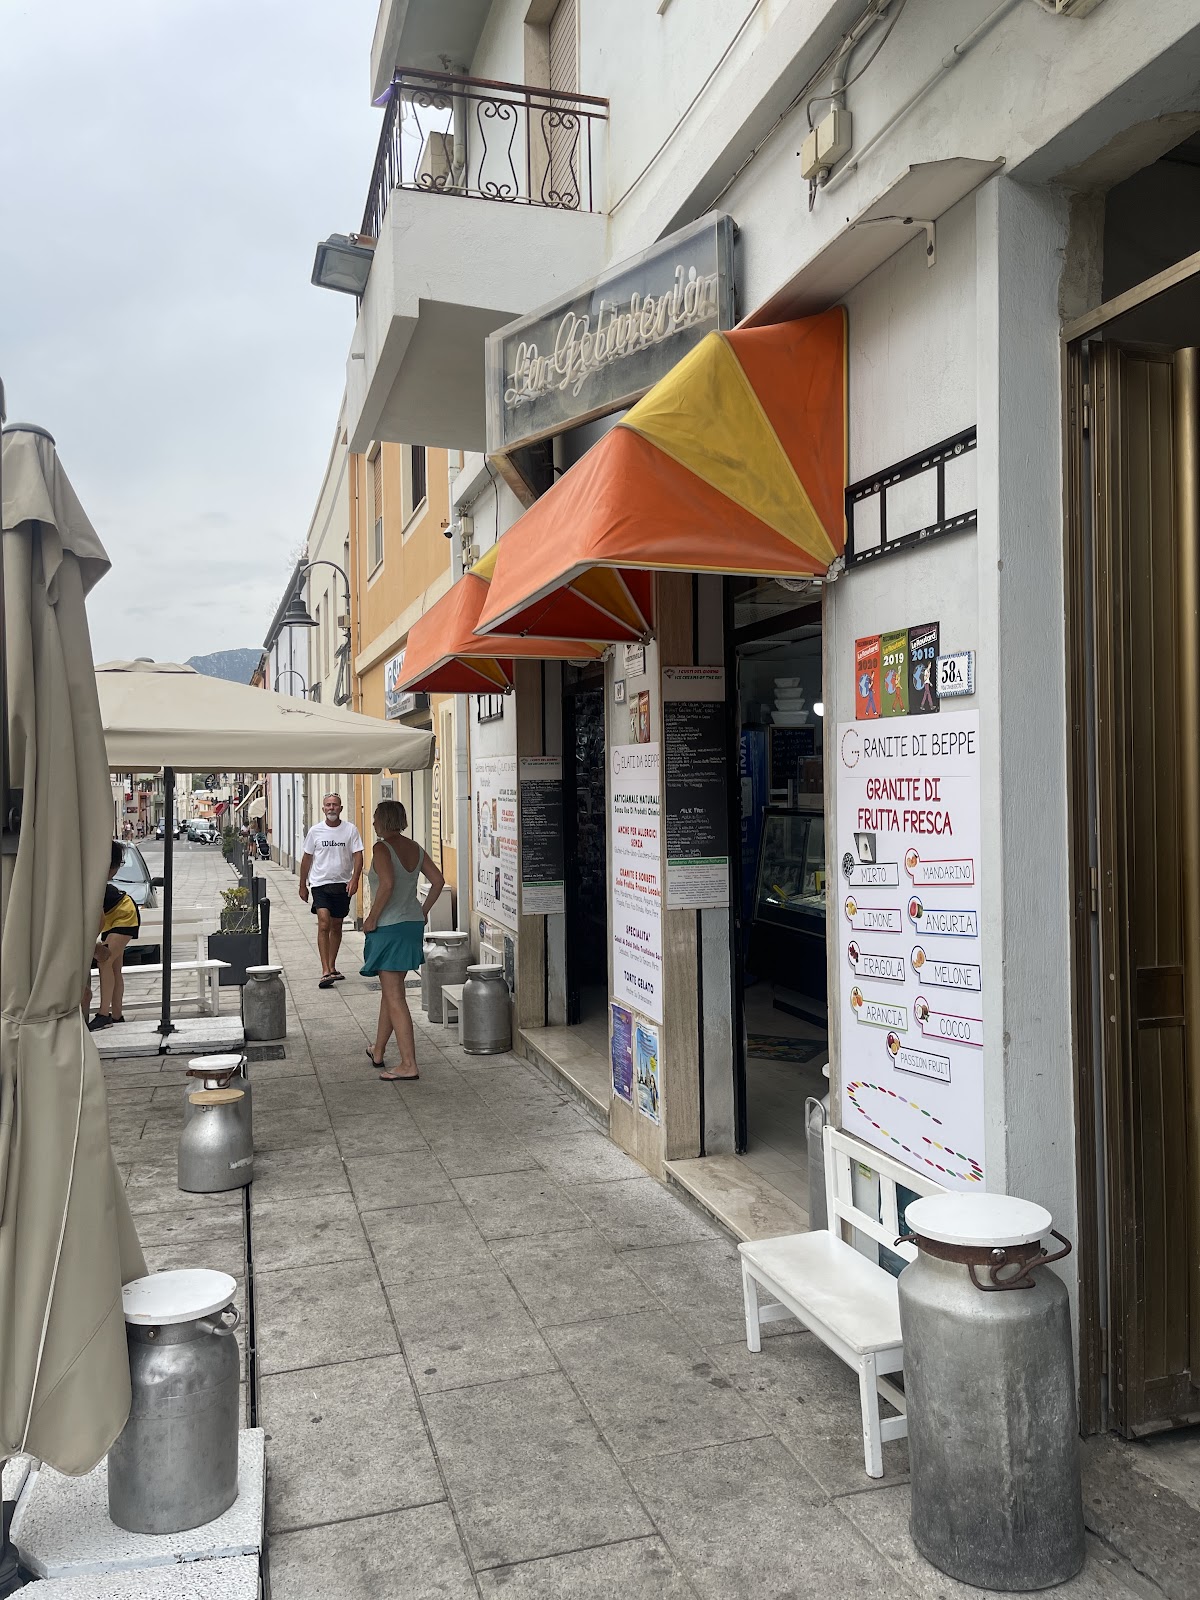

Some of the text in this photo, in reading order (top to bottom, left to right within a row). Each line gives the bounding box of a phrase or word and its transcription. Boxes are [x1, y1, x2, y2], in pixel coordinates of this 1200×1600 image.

[883, 652, 905, 666] 2019
[912, 646, 935, 662] 2018
[858, 657, 878, 671] 2020
[912, 733, 928, 757] DI
[932, 730, 976, 757] BEPPE
[866, 777, 941, 802] GRANITE DI
[858, 807, 953, 836] FRUTTA FRESCA
[861, 867, 887, 883] MIRTO
[922, 865, 971, 880] MANDARINO
[863, 912, 894, 928] LIMONE
[925, 914, 974, 933] ANGURIA
[863, 957, 904, 978] FRAGOLA
[934, 966, 973, 986] MELONE
[637, 977, 654, 994] GELATO
[866, 1005, 904, 1027] ARANCIA
[939, 1018, 971, 1040] COCCO
[900, 1052, 949, 1075] PASSION FRUIT
